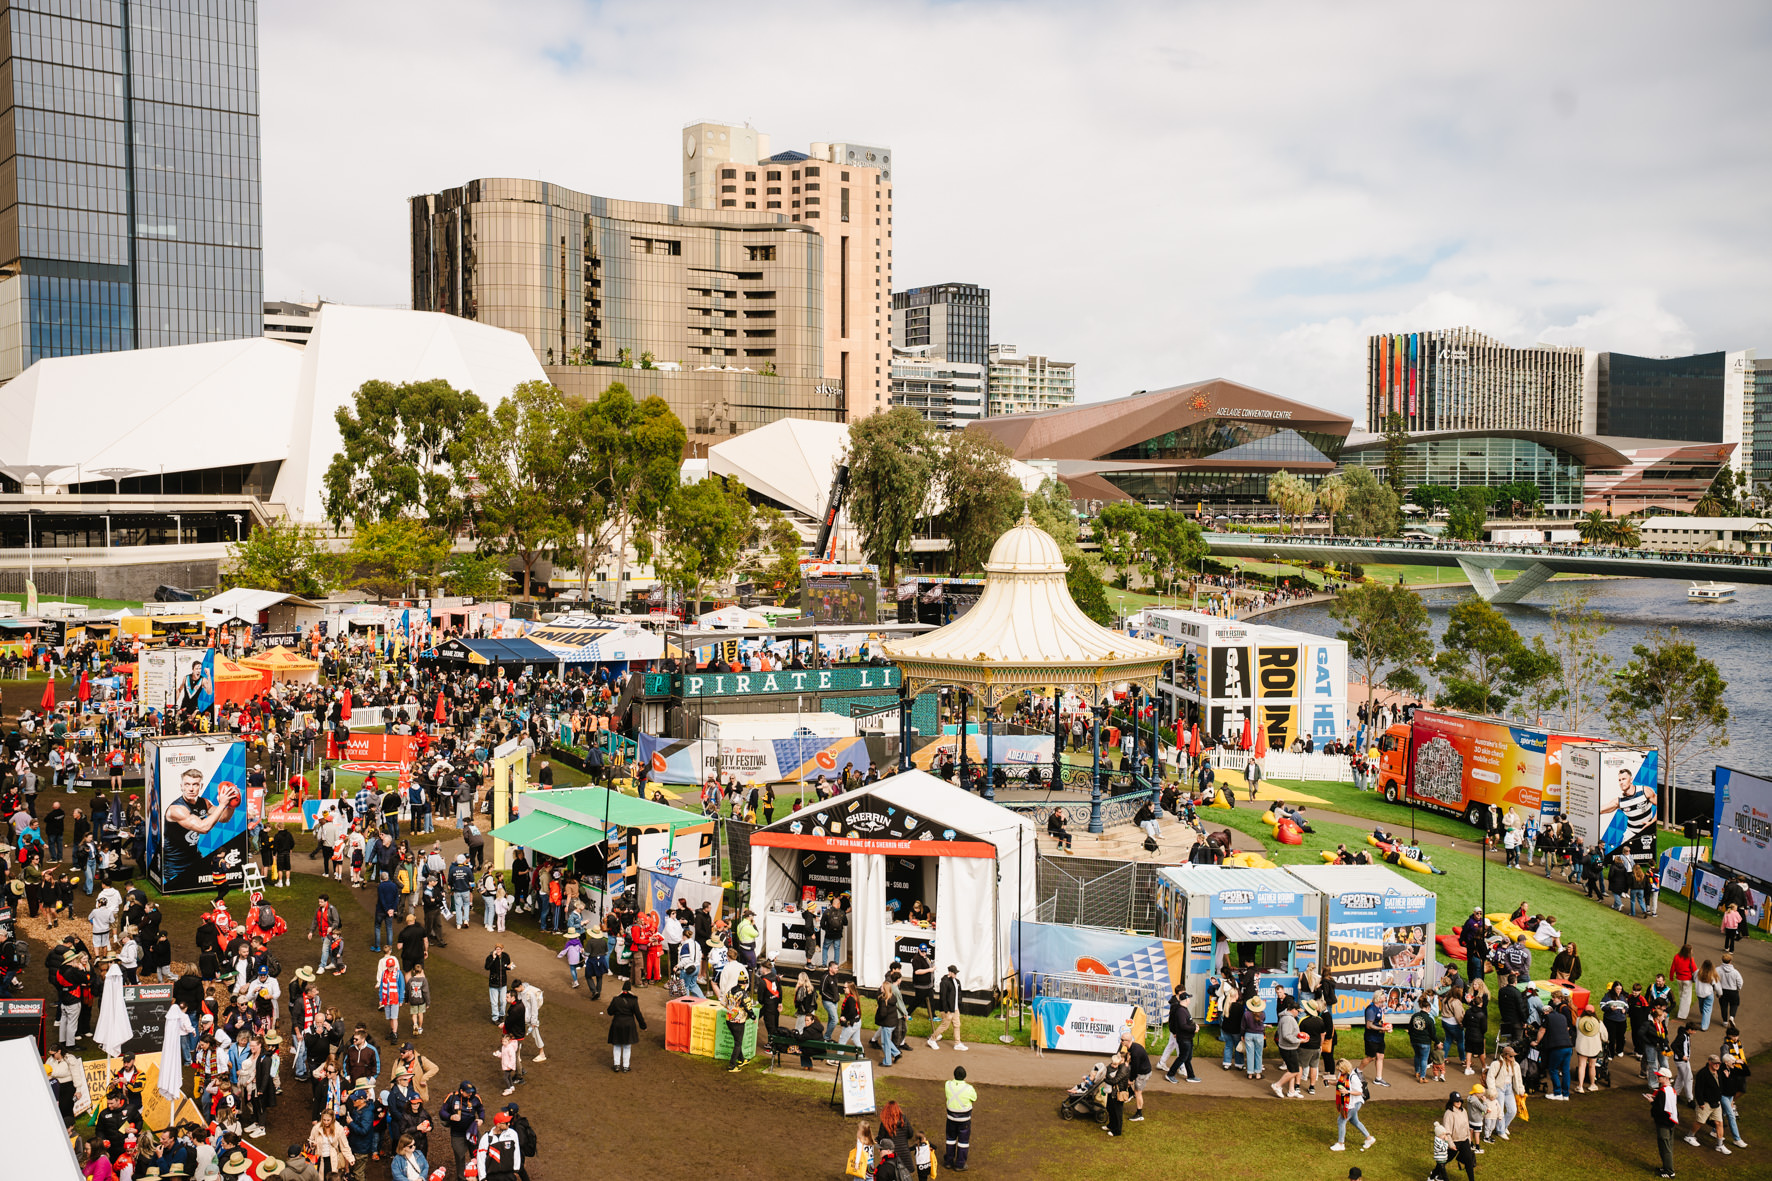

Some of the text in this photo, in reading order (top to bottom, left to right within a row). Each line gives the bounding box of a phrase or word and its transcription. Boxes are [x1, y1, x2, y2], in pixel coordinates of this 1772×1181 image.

[1216, 408, 1292, 419] ADELAIDE CONVENTION CENTRE
[269, 636, 294, 648] NEVER
[453, 650, 464, 658] ZONE
[690, 670, 892, 694] PIRATE LI
[1224, 648, 1243, 740] GATHE
[346, 740, 369, 748] AAMI
[1475, 738, 1507, 750] Australia's first
[1520, 738, 1544, 748] sportsbet
[736, 754, 767, 766] FESTIVAL
[1008, 751, 1037, 762] ADELAIDE
[846, 812, 892, 827] SHERRIN
[1735, 812, 1772, 838] FOOTY FESTIVA
[1407, 849, 1417, 859] 23
[809, 874, 839, 883] PERSONALISED
[1219, 890, 1254, 900] SPORTS
[1258, 893, 1294, 902] GATHER ROUND
[1340, 894, 1382, 905] SPORTS
[1385, 897, 1426, 906] GATHER ROUND
[788, 932, 802, 940] ORDER
[1330, 926, 1383, 940] GATHER
[1329, 945, 1383, 966] ROUND
[142, 1025, 159, 1033] $3.50
[1071, 1021, 1114, 1032] FOOTY FESTIVAL
[84, 1062, 106, 1070] coles
[226, 1095, 235, 1107] 9
